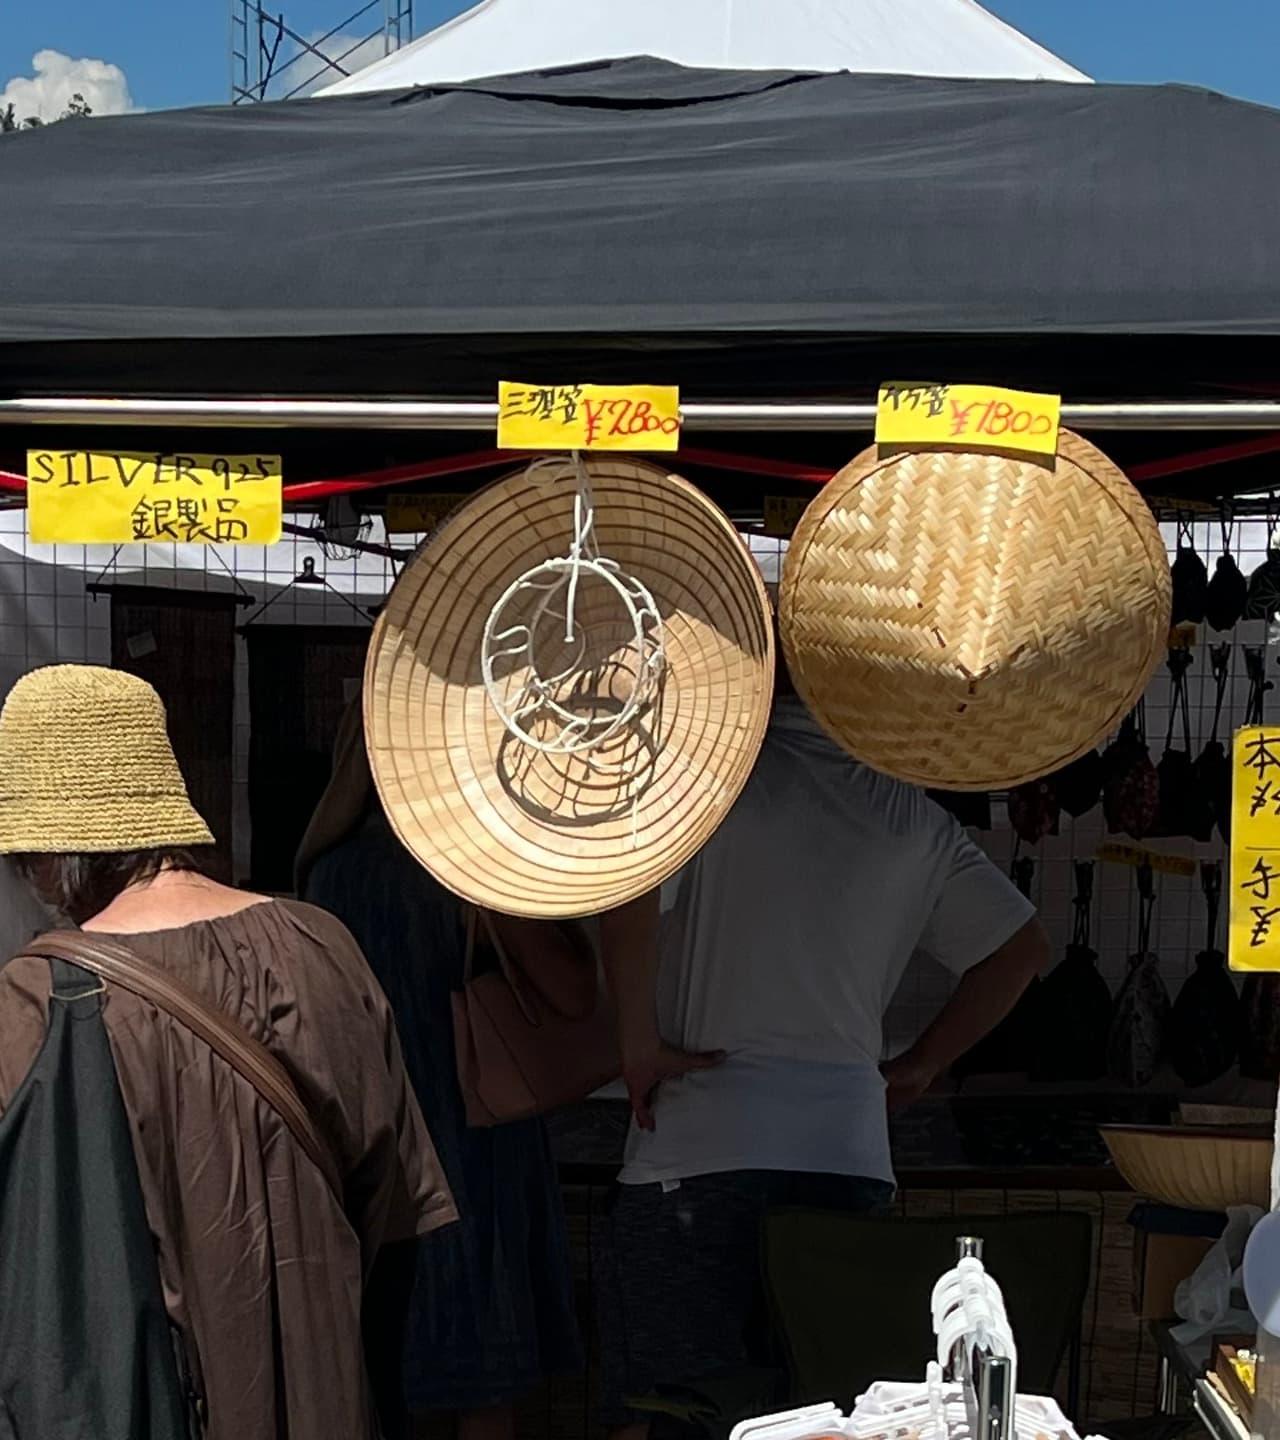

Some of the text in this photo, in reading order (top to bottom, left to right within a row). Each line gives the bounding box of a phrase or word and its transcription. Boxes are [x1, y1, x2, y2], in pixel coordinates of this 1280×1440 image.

[31, 452, 275, 490] SILVER 925
[131, 494, 248, 543] 銀製品
